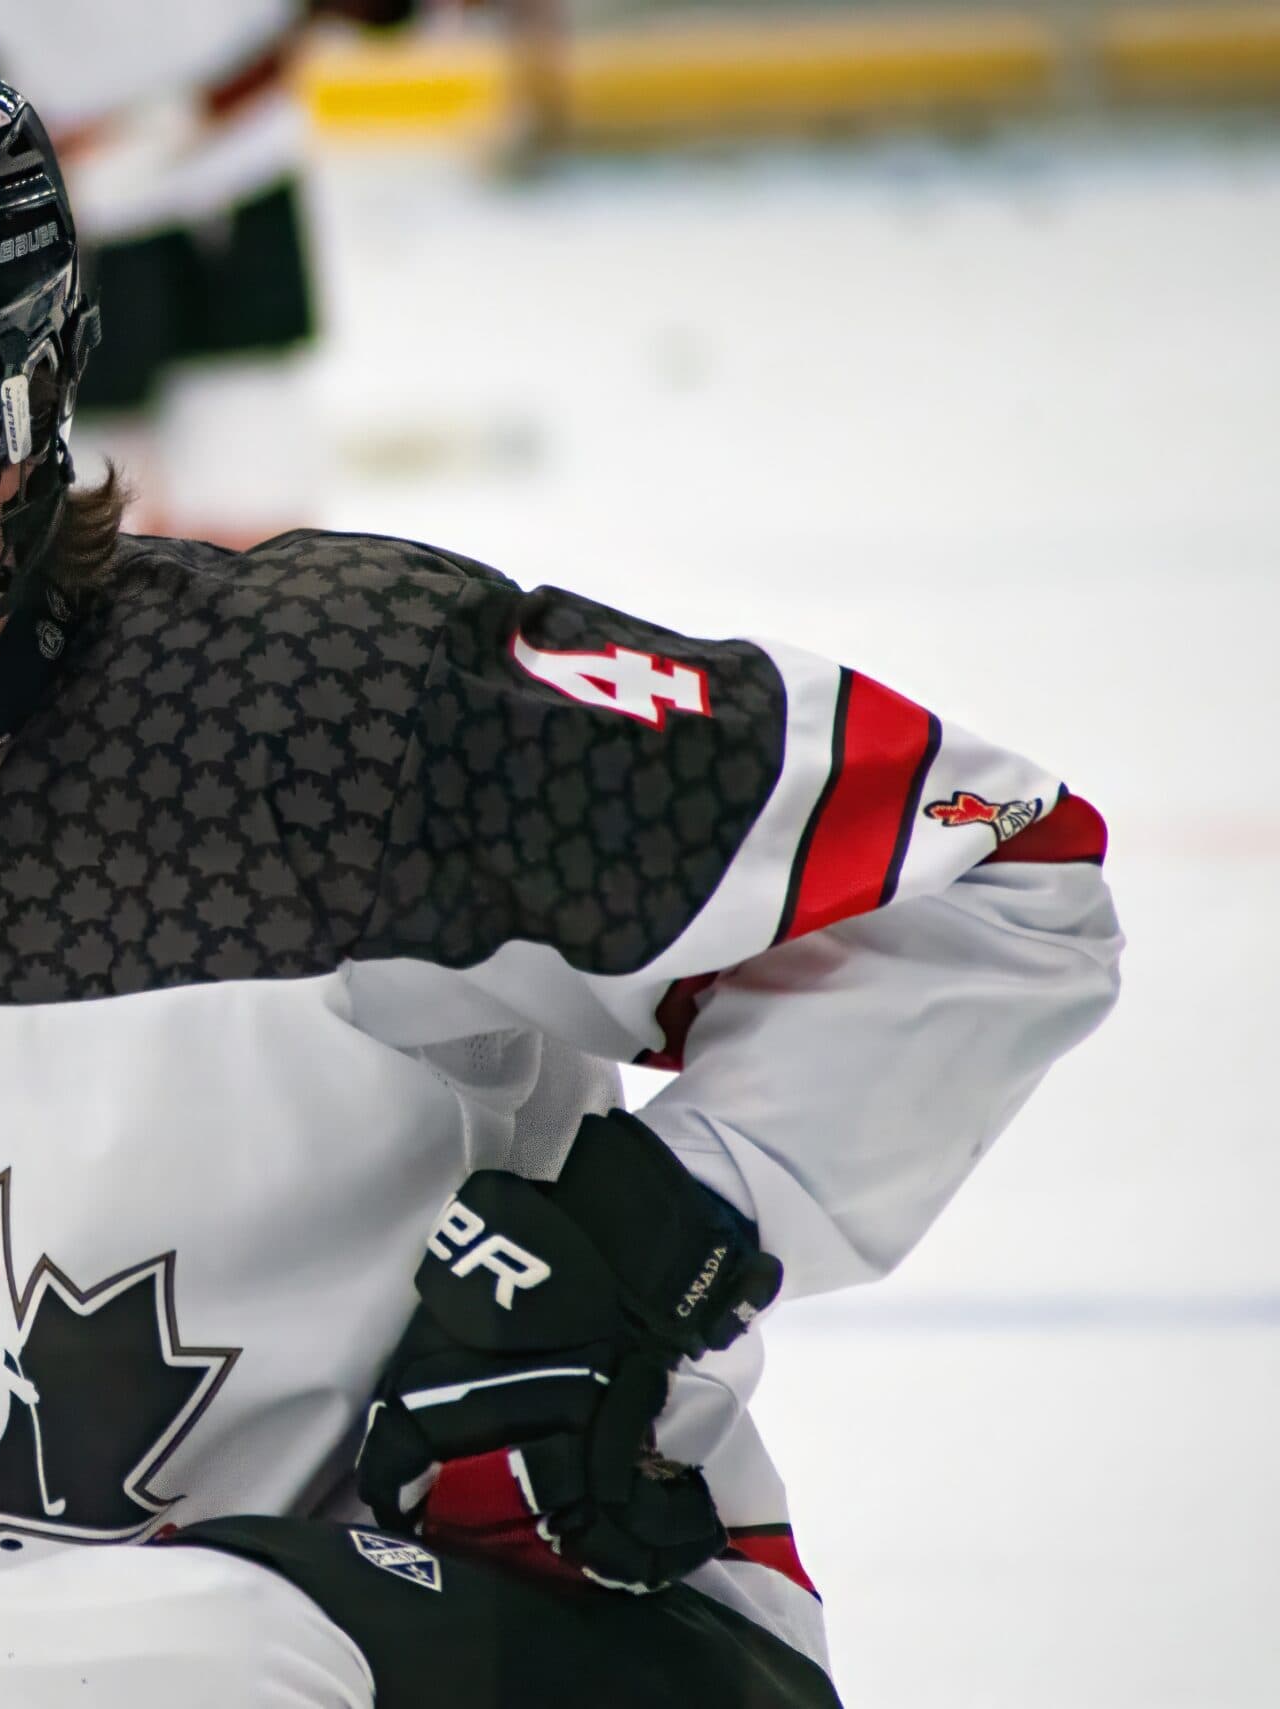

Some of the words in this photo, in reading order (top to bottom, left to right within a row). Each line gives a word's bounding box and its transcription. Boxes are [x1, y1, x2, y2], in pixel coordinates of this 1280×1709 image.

[0, 220, 60, 264] BAUER
[510, 627, 712, 732] 4
[675, 1246, 728, 1318] CANADA
